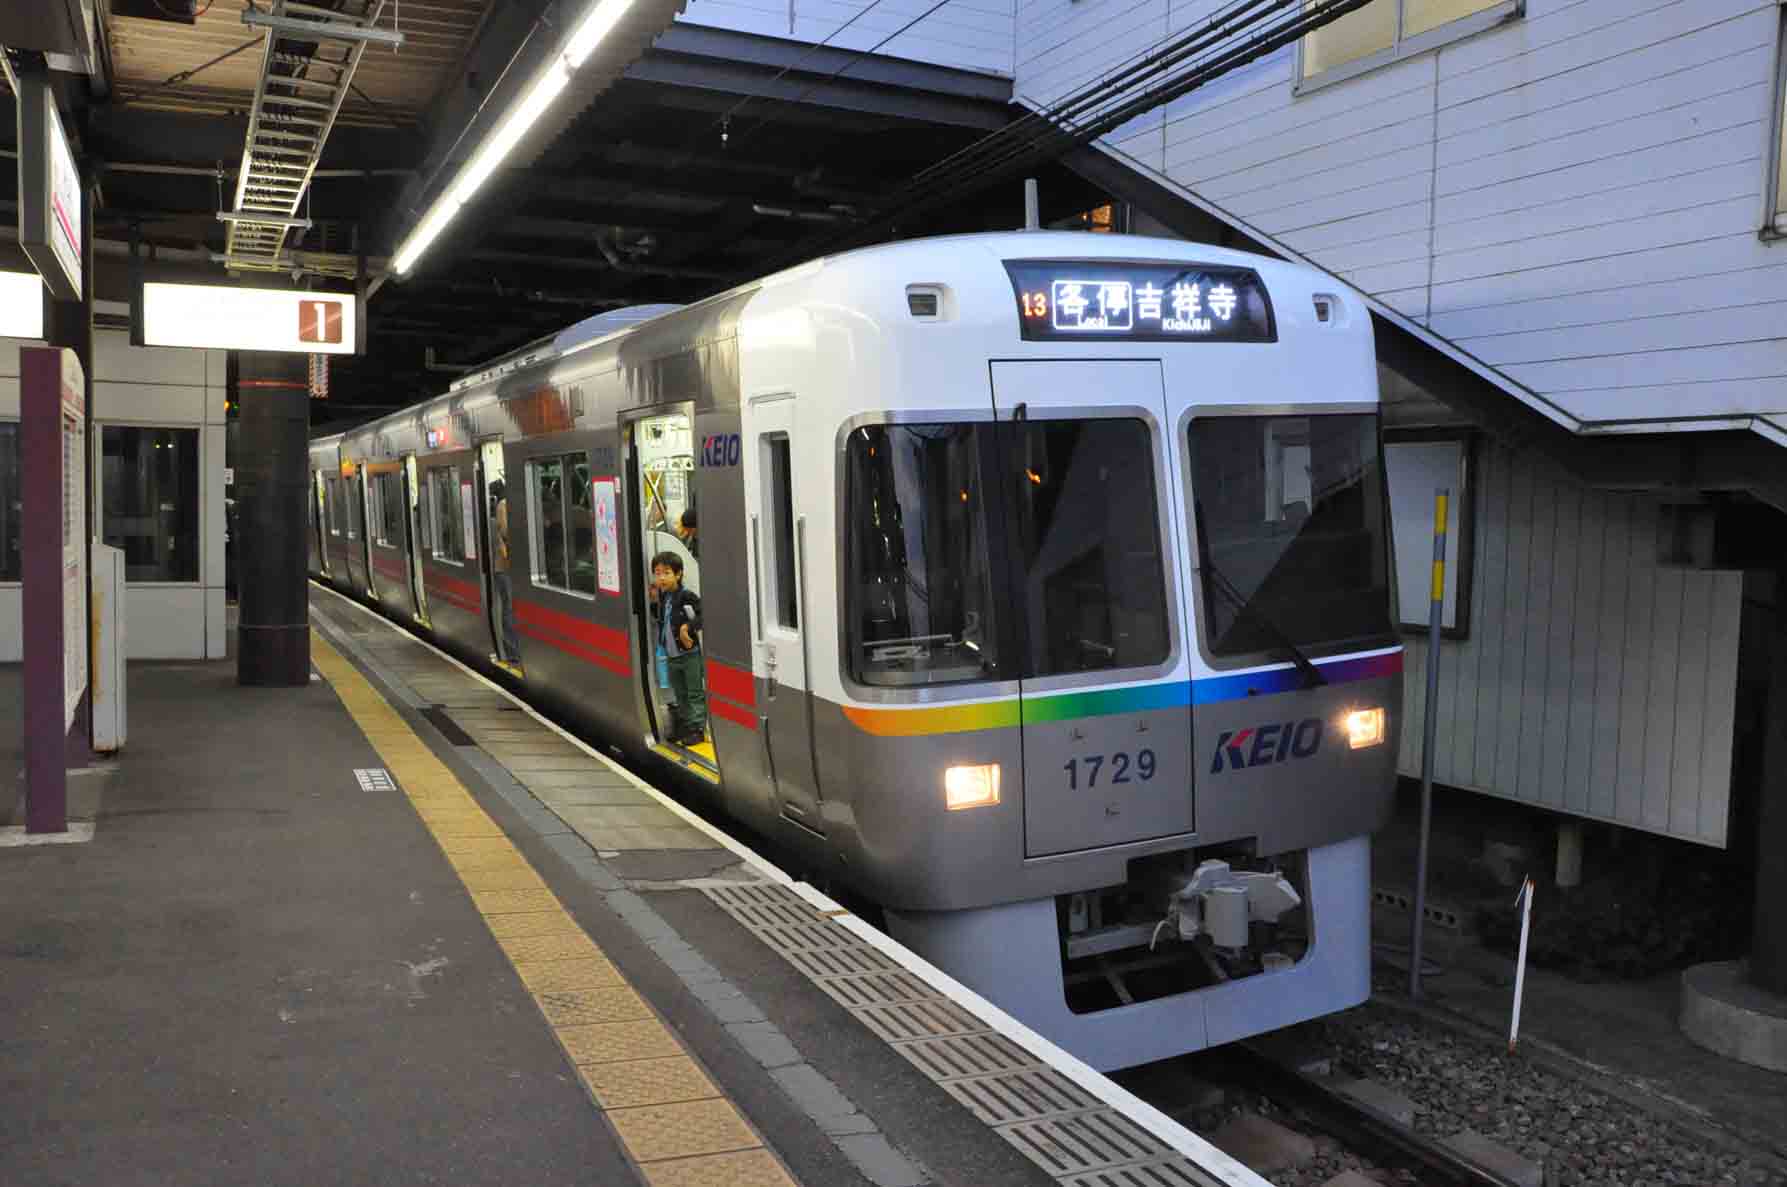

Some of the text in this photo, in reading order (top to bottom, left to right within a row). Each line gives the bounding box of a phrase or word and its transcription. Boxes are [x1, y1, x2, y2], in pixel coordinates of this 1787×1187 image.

[1021, 291, 1047, 318] 13
[1057, 283, 1129, 317] 各停
[1135, 280, 1237, 321] 吉祥寺
[313, 302, 326, 342] 1
[700, 432, 740, 467] KEIO
[1210, 718, 1325, 775] KEIO
[1063, 748, 1157, 791] 1729
